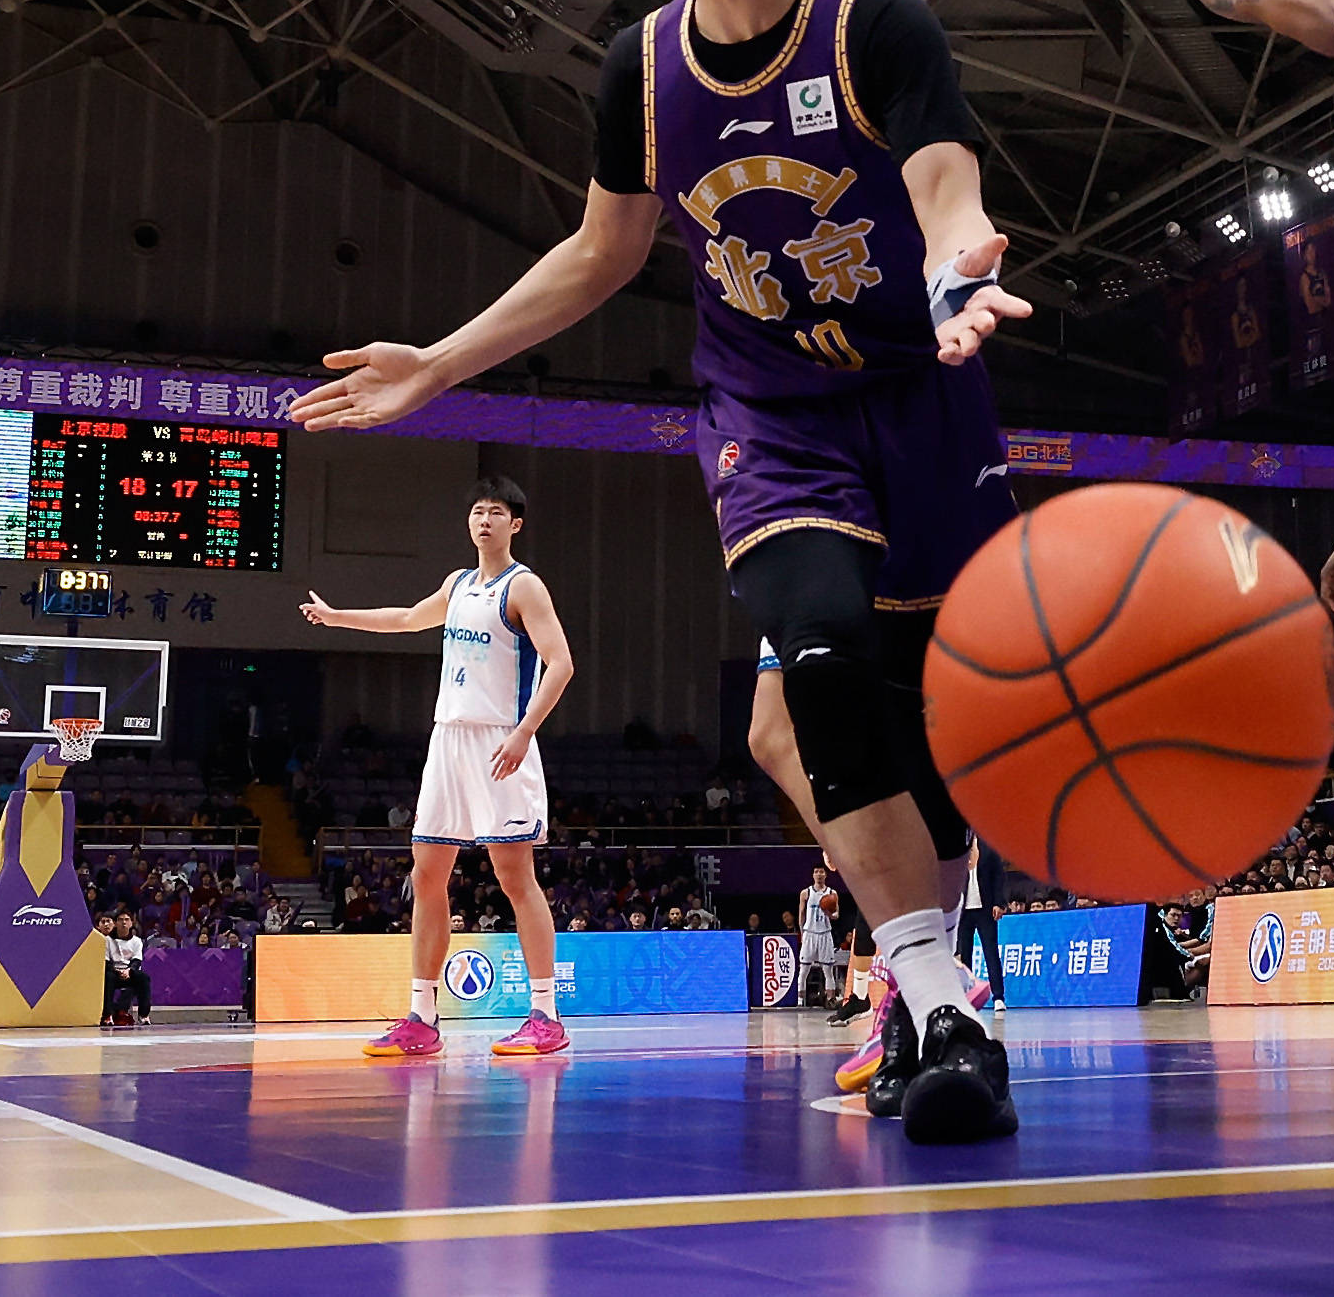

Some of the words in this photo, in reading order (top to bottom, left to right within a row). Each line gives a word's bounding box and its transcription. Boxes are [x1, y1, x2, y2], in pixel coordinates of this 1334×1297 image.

[705, 218, 883, 321] 北京
[153, 426, 171, 440] VS
[1007, 445, 1072, 462] BG北控
[119, 477, 147, 496] 18
[171, 479, 199, 498] 17
[12, 918, 63, 926] LI-NING
[779, 946, 790, 989] 百岁山
[554, 982, 576, 992] 026
